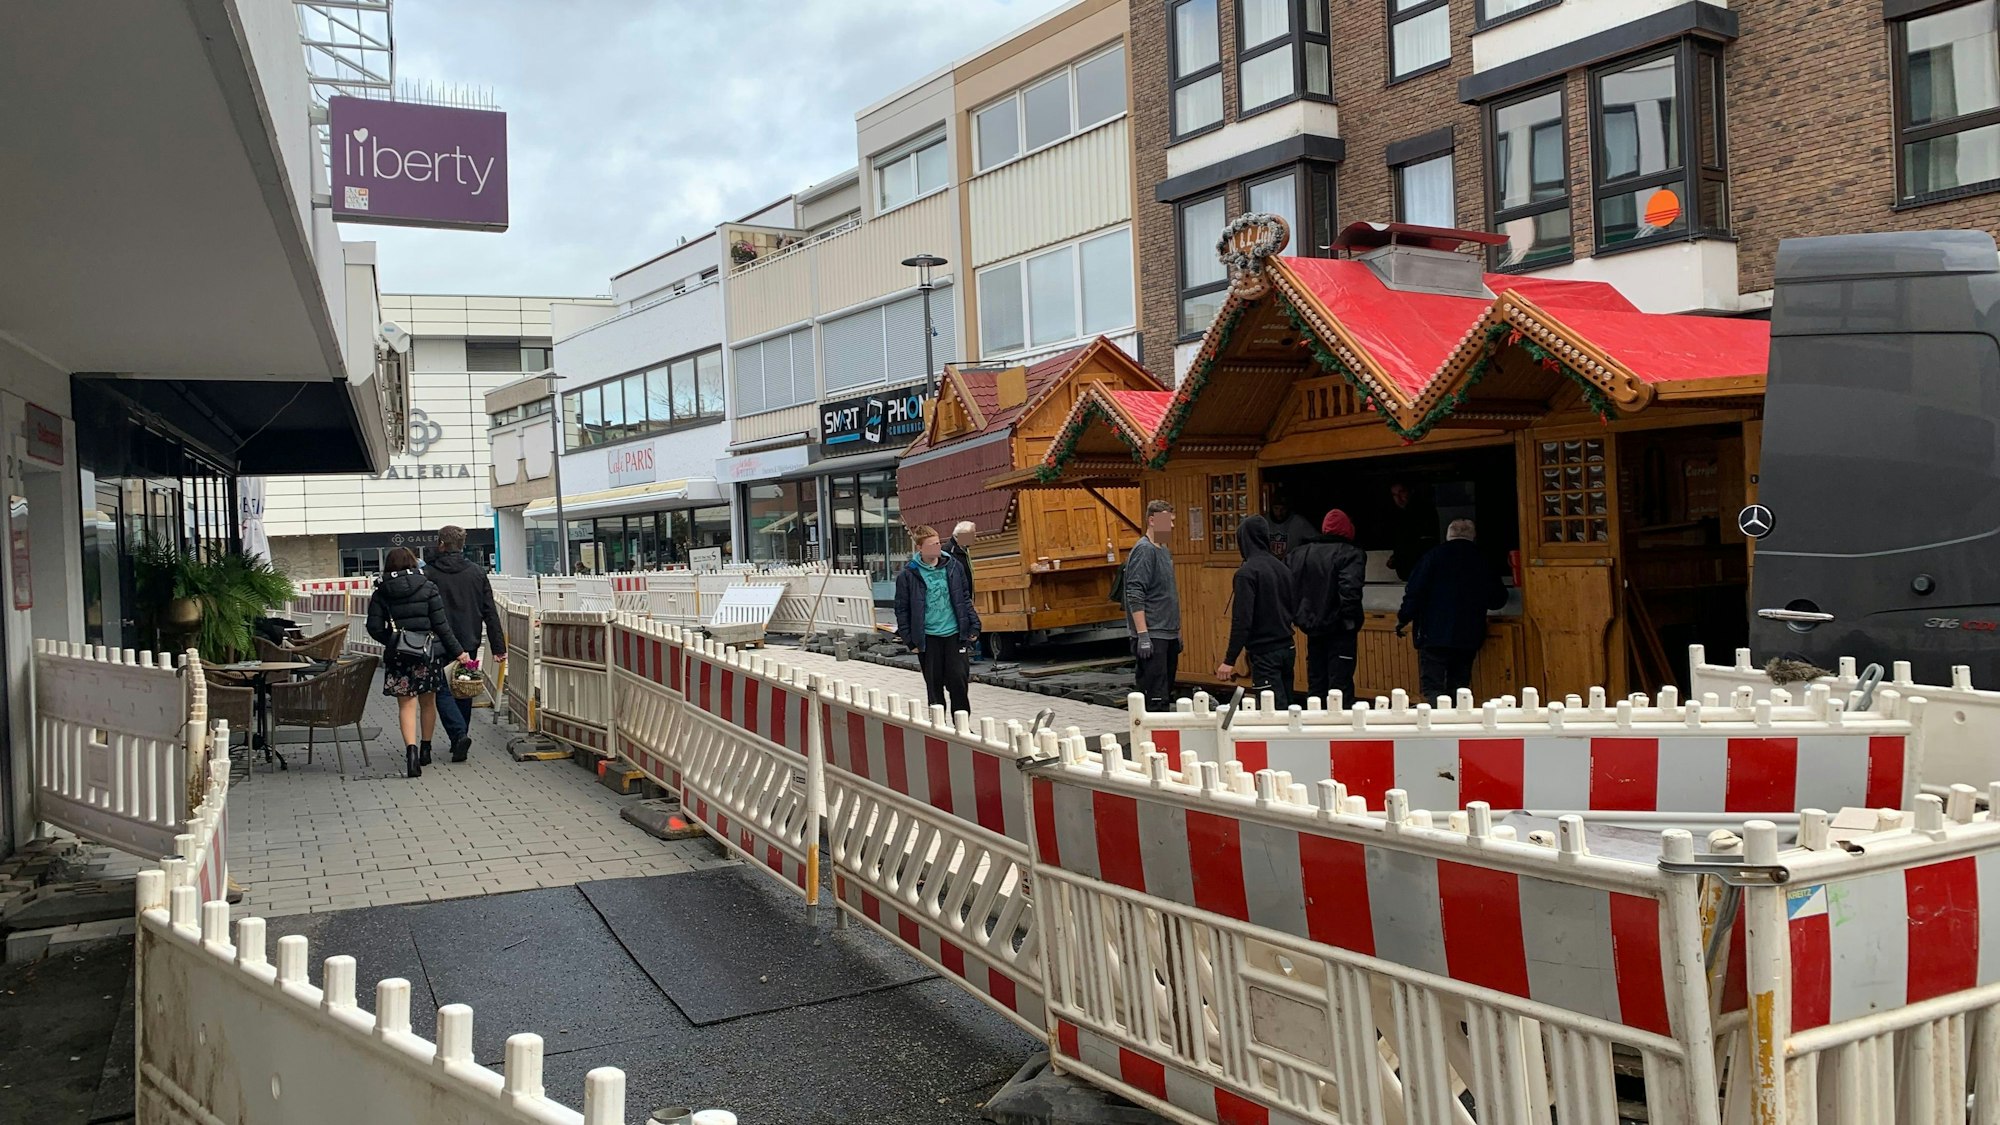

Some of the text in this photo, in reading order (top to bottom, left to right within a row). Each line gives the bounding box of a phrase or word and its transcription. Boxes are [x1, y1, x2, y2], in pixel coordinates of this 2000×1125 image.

[344, 127, 495, 195] liberty
[824, 406, 859, 434] SMART
[625, 447, 653, 473] PARIS
[1924, 617, 1960, 629] 316
[1787, 888, 1812, 900] KREITZ
